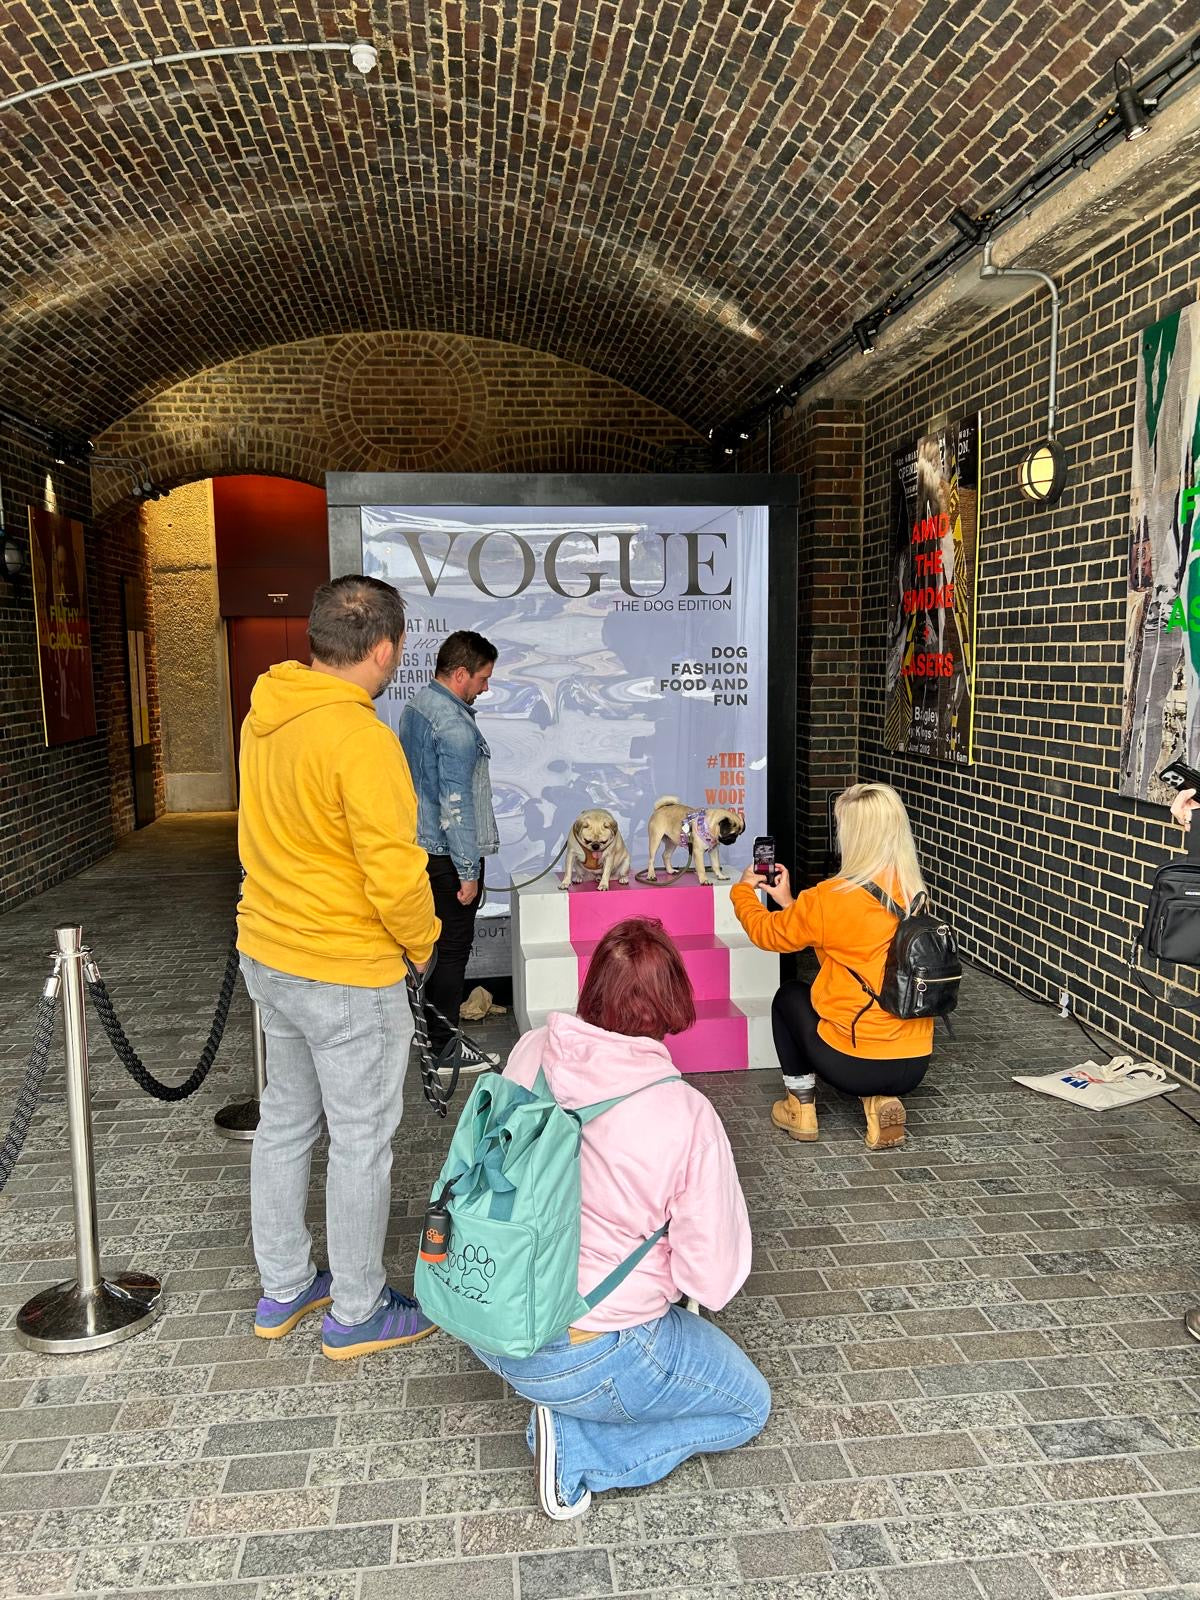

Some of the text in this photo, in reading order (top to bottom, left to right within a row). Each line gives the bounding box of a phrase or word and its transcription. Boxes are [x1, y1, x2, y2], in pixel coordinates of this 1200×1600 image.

[911, 512, 950, 544] AMID
[400, 530, 733, 599] VOGUE
[915, 550, 944, 576] THE
[613, 599, 732, 612] THE DOG EDITION
[903, 583, 954, 615] SMOKE
[427, 618, 449, 632] ALL
[712, 646, 748, 659] DOG
[671, 662, 748, 675] FASHION
[660, 678, 748, 692] FOOD AND
[387, 686, 415, 700] THIS
[714, 694, 748, 706] FUN
[707, 752, 745, 768] #THE
[719, 770, 745, 786] BIG
[704, 788, 745, 805] WOOF
[477, 927, 507, 938] OUT
